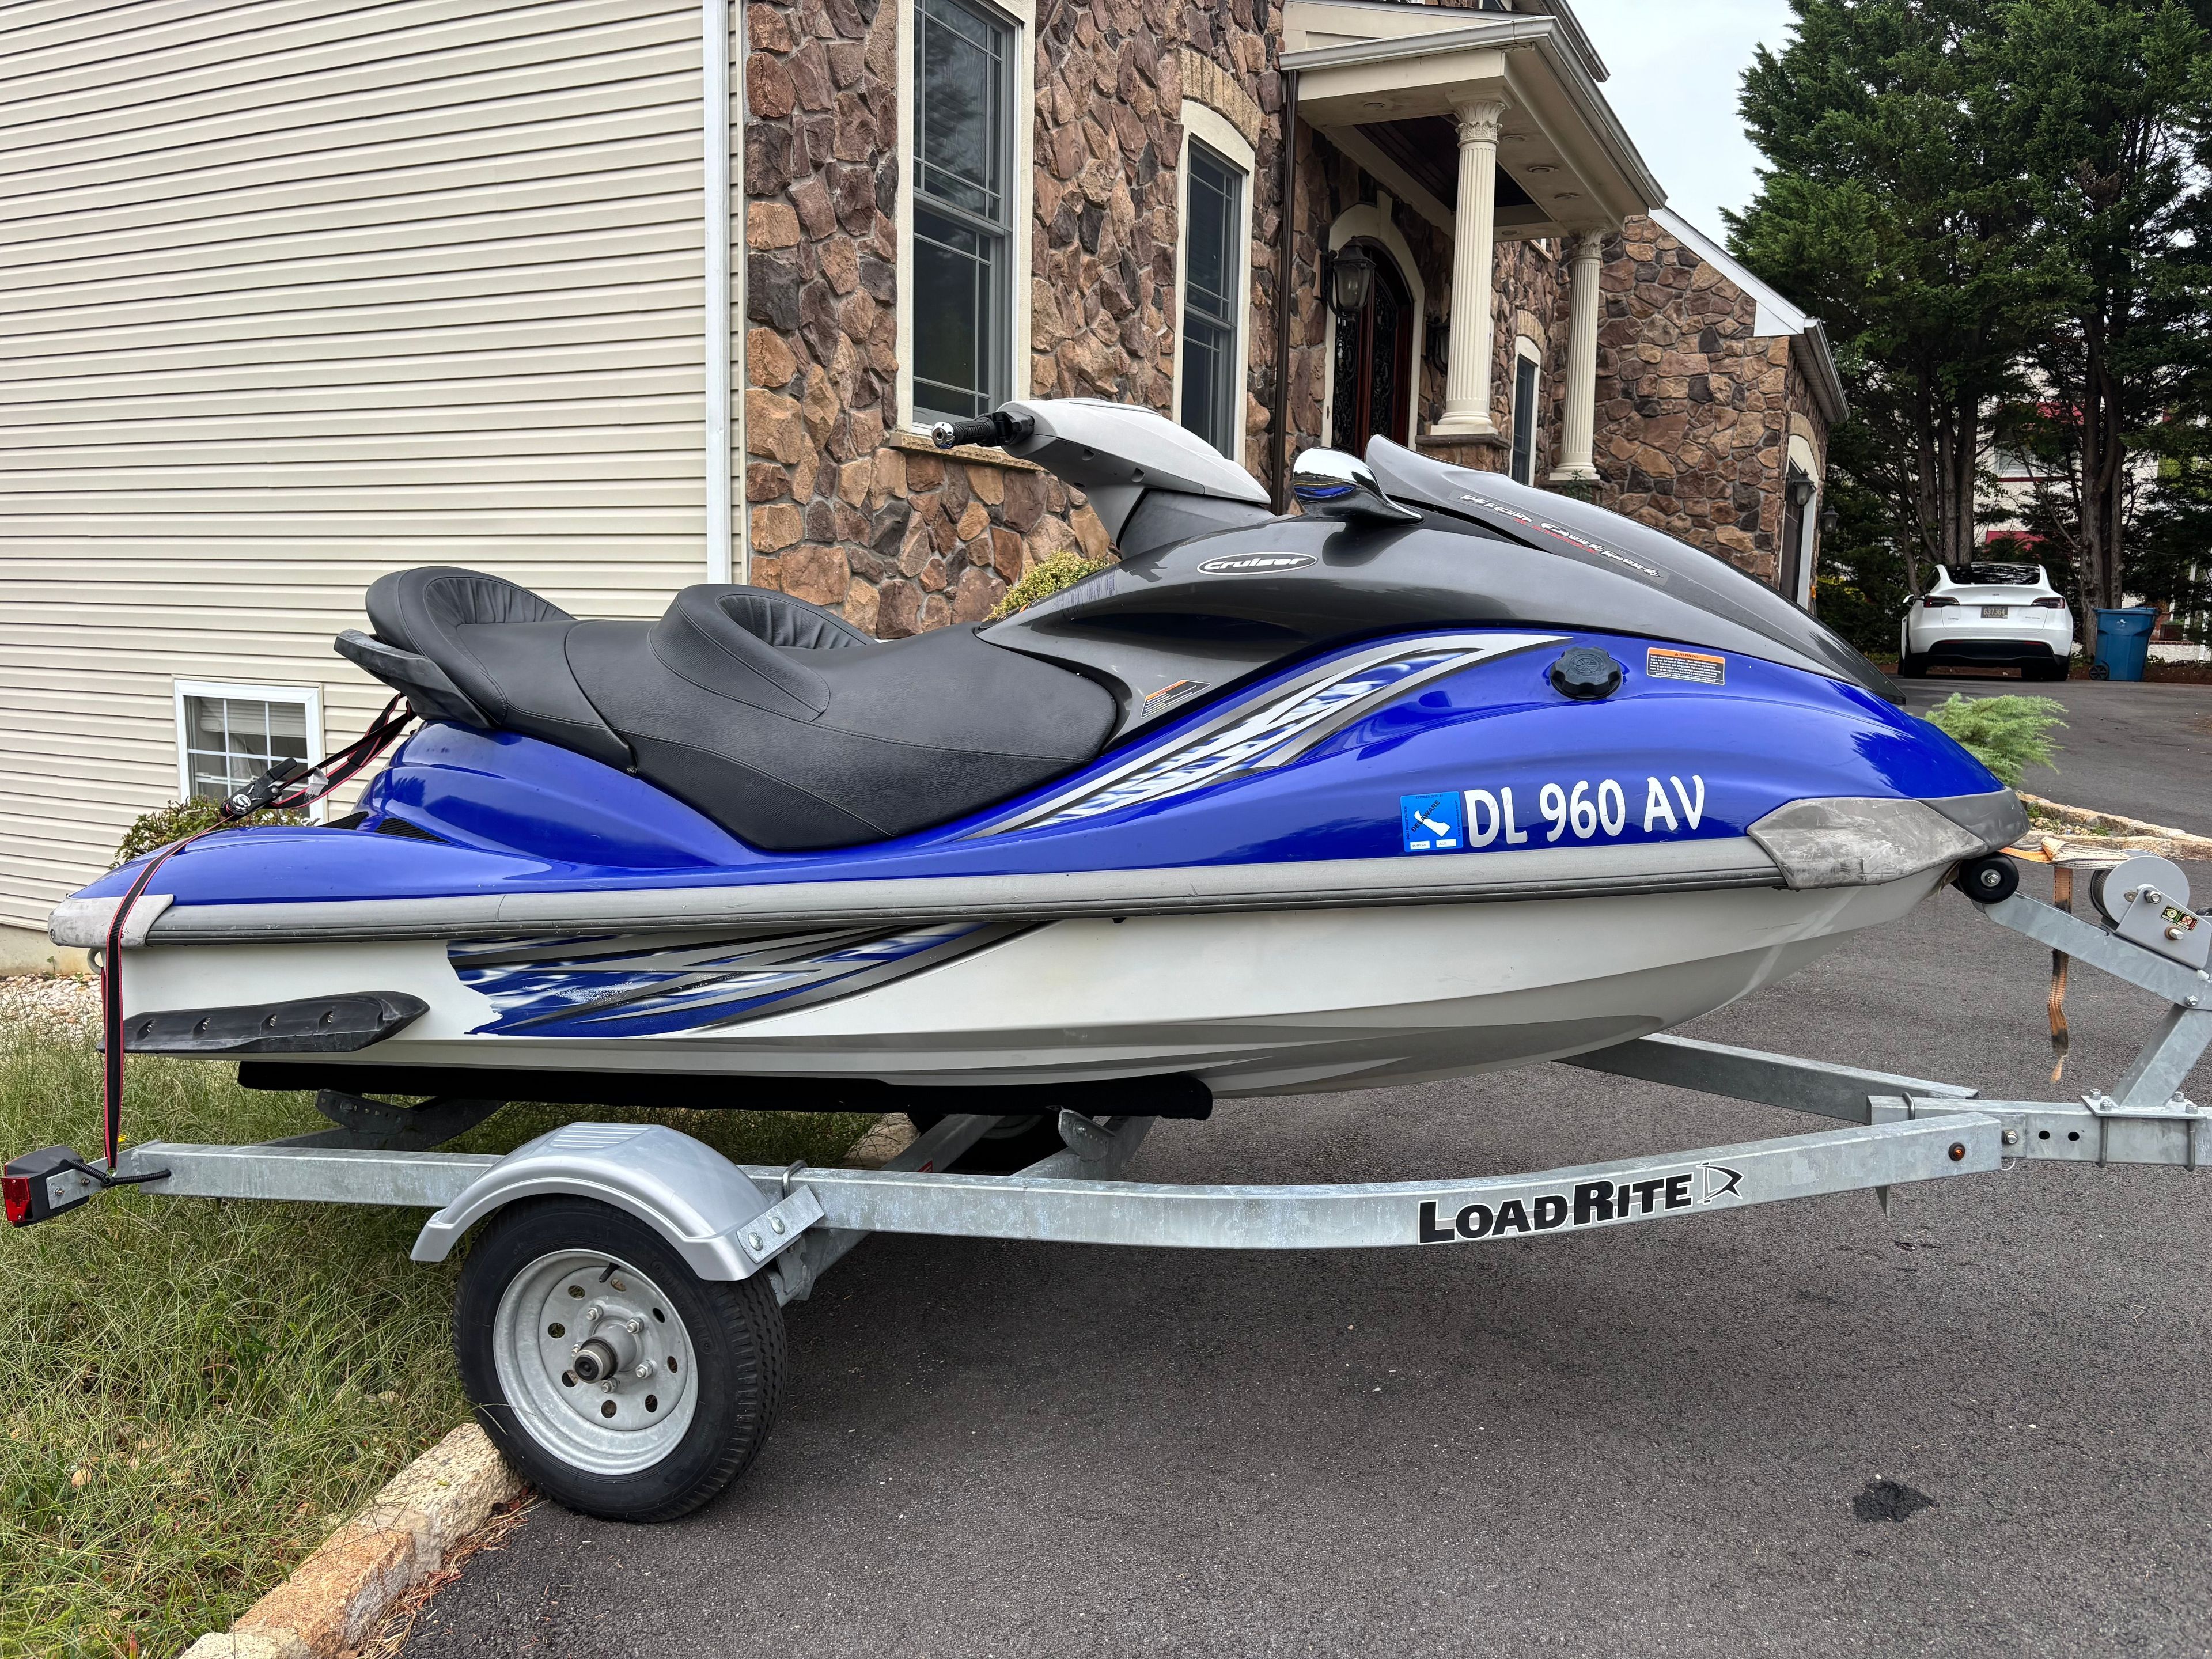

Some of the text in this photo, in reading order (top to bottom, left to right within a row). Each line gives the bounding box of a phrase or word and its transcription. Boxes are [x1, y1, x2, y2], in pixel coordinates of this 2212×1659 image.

[1203, 558, 1309, 570] Cruiser
[1411, 800, 1440, 832] DELAWARE
[1464, 787, 1528, 847] DL
[1540, 779, 1626, 842] 960
[1643, 775, 1705, 832] AV
[1418, 1172, 1694, 1244] LOADRITE
